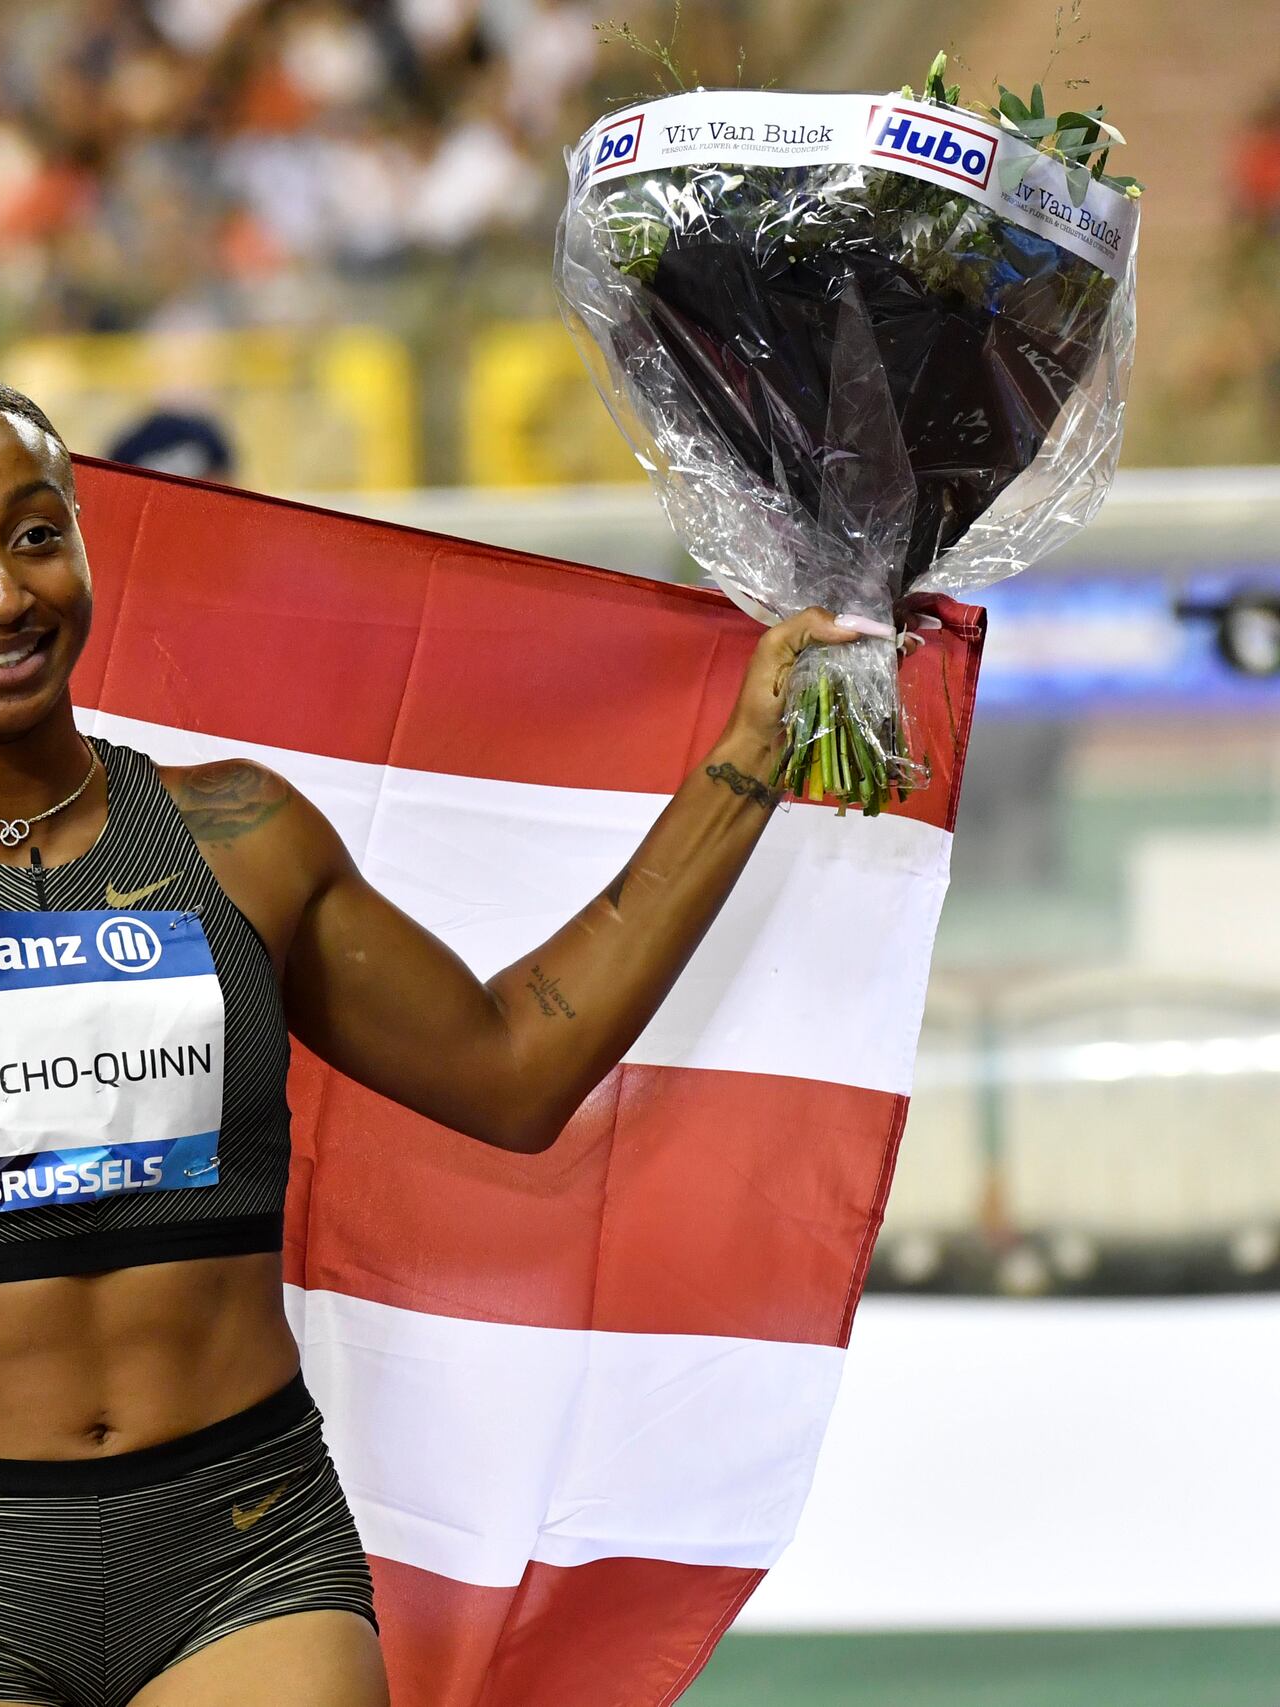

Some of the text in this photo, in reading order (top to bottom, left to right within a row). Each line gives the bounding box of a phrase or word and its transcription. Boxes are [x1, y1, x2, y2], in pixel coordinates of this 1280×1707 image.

[661, 144, 698, 155] PERSONAL
[699, 142, 731, 150] FLOWER
[741, 143, 790, 154] CHRISTMAS
[791, 145, 830, 154] CONCEPTS
[665, 121, 834, 144] Viv Van Bulck
[875, 116, 986, 176] Hubo
[1039, 188, 1072, 224] Van
[1076, 208, 1122, 252] Bulck
